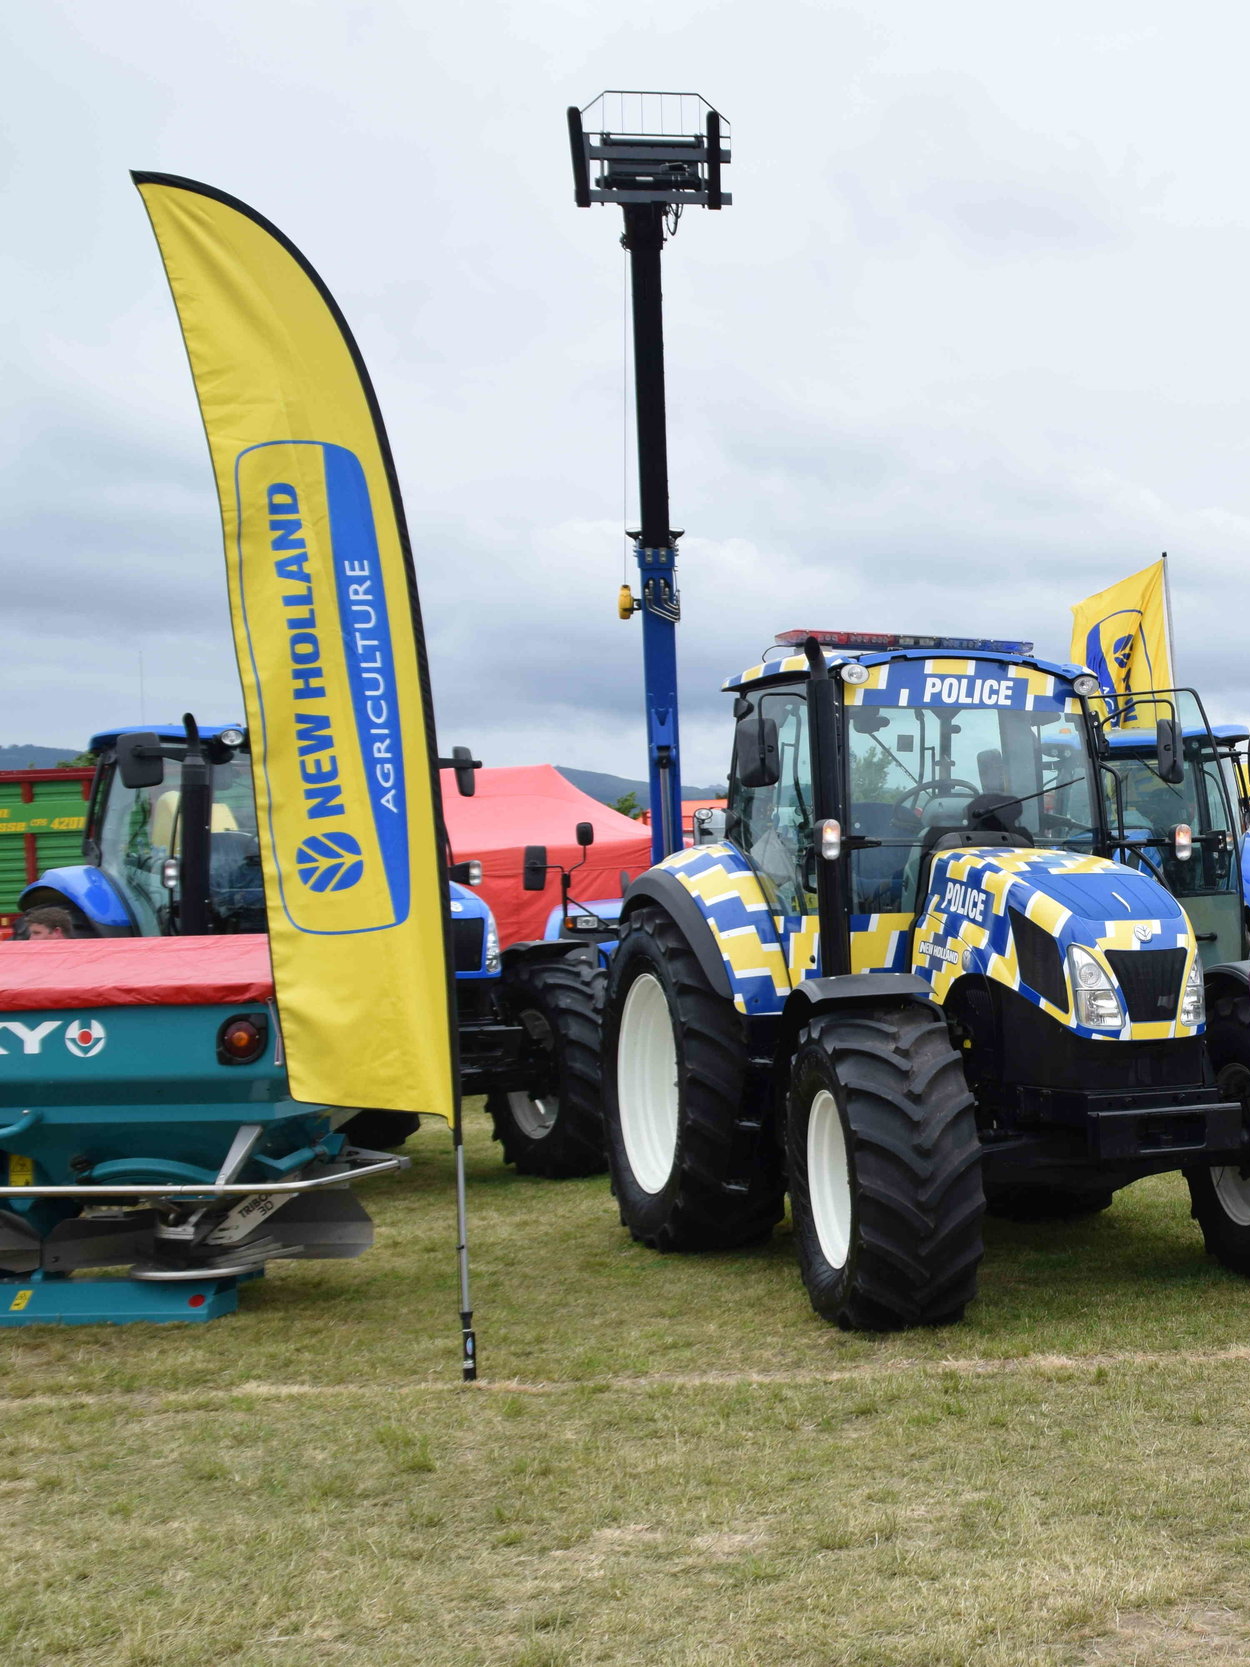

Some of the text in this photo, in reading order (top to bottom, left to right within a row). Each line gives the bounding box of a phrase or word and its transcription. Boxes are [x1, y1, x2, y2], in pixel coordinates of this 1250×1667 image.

[266, 482, 346, 820] NEW HOLLAND
[344, 559, 399, 813] AGRICULTURE
[923, 677, 1013, 705] POLICE
[941, 881, 986, 922] POLICE
[919, 941, 959, 965] NEW HOLLAND
[238, 1194, 272, 1218] TRIBO
[257, 1201, 273, 1216] 3D
